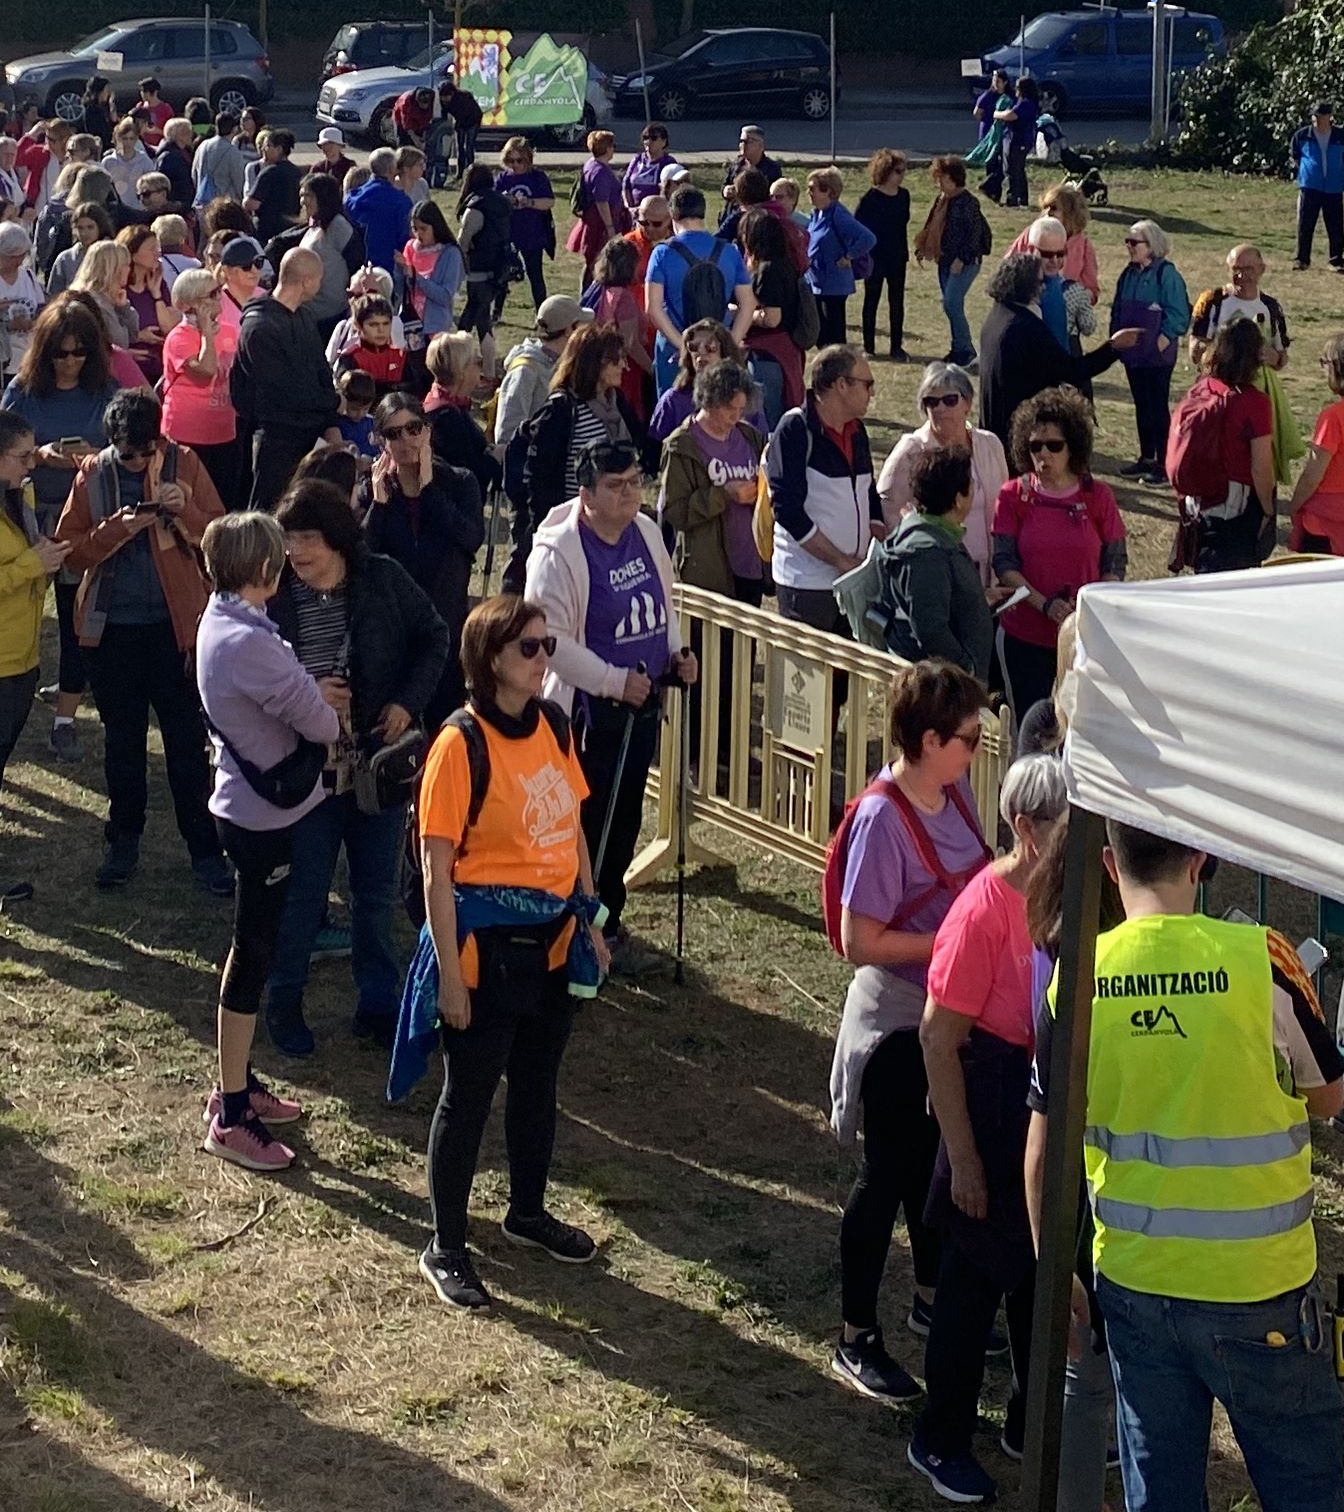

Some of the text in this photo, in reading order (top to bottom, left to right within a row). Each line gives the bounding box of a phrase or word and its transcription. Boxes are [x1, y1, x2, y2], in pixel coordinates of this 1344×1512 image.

[514, 95, 578, 107] CERDANYOLA
[609, 556, 646, 585] DONES
[1094, 966, 1230, 999] RGANITZACIÓ
